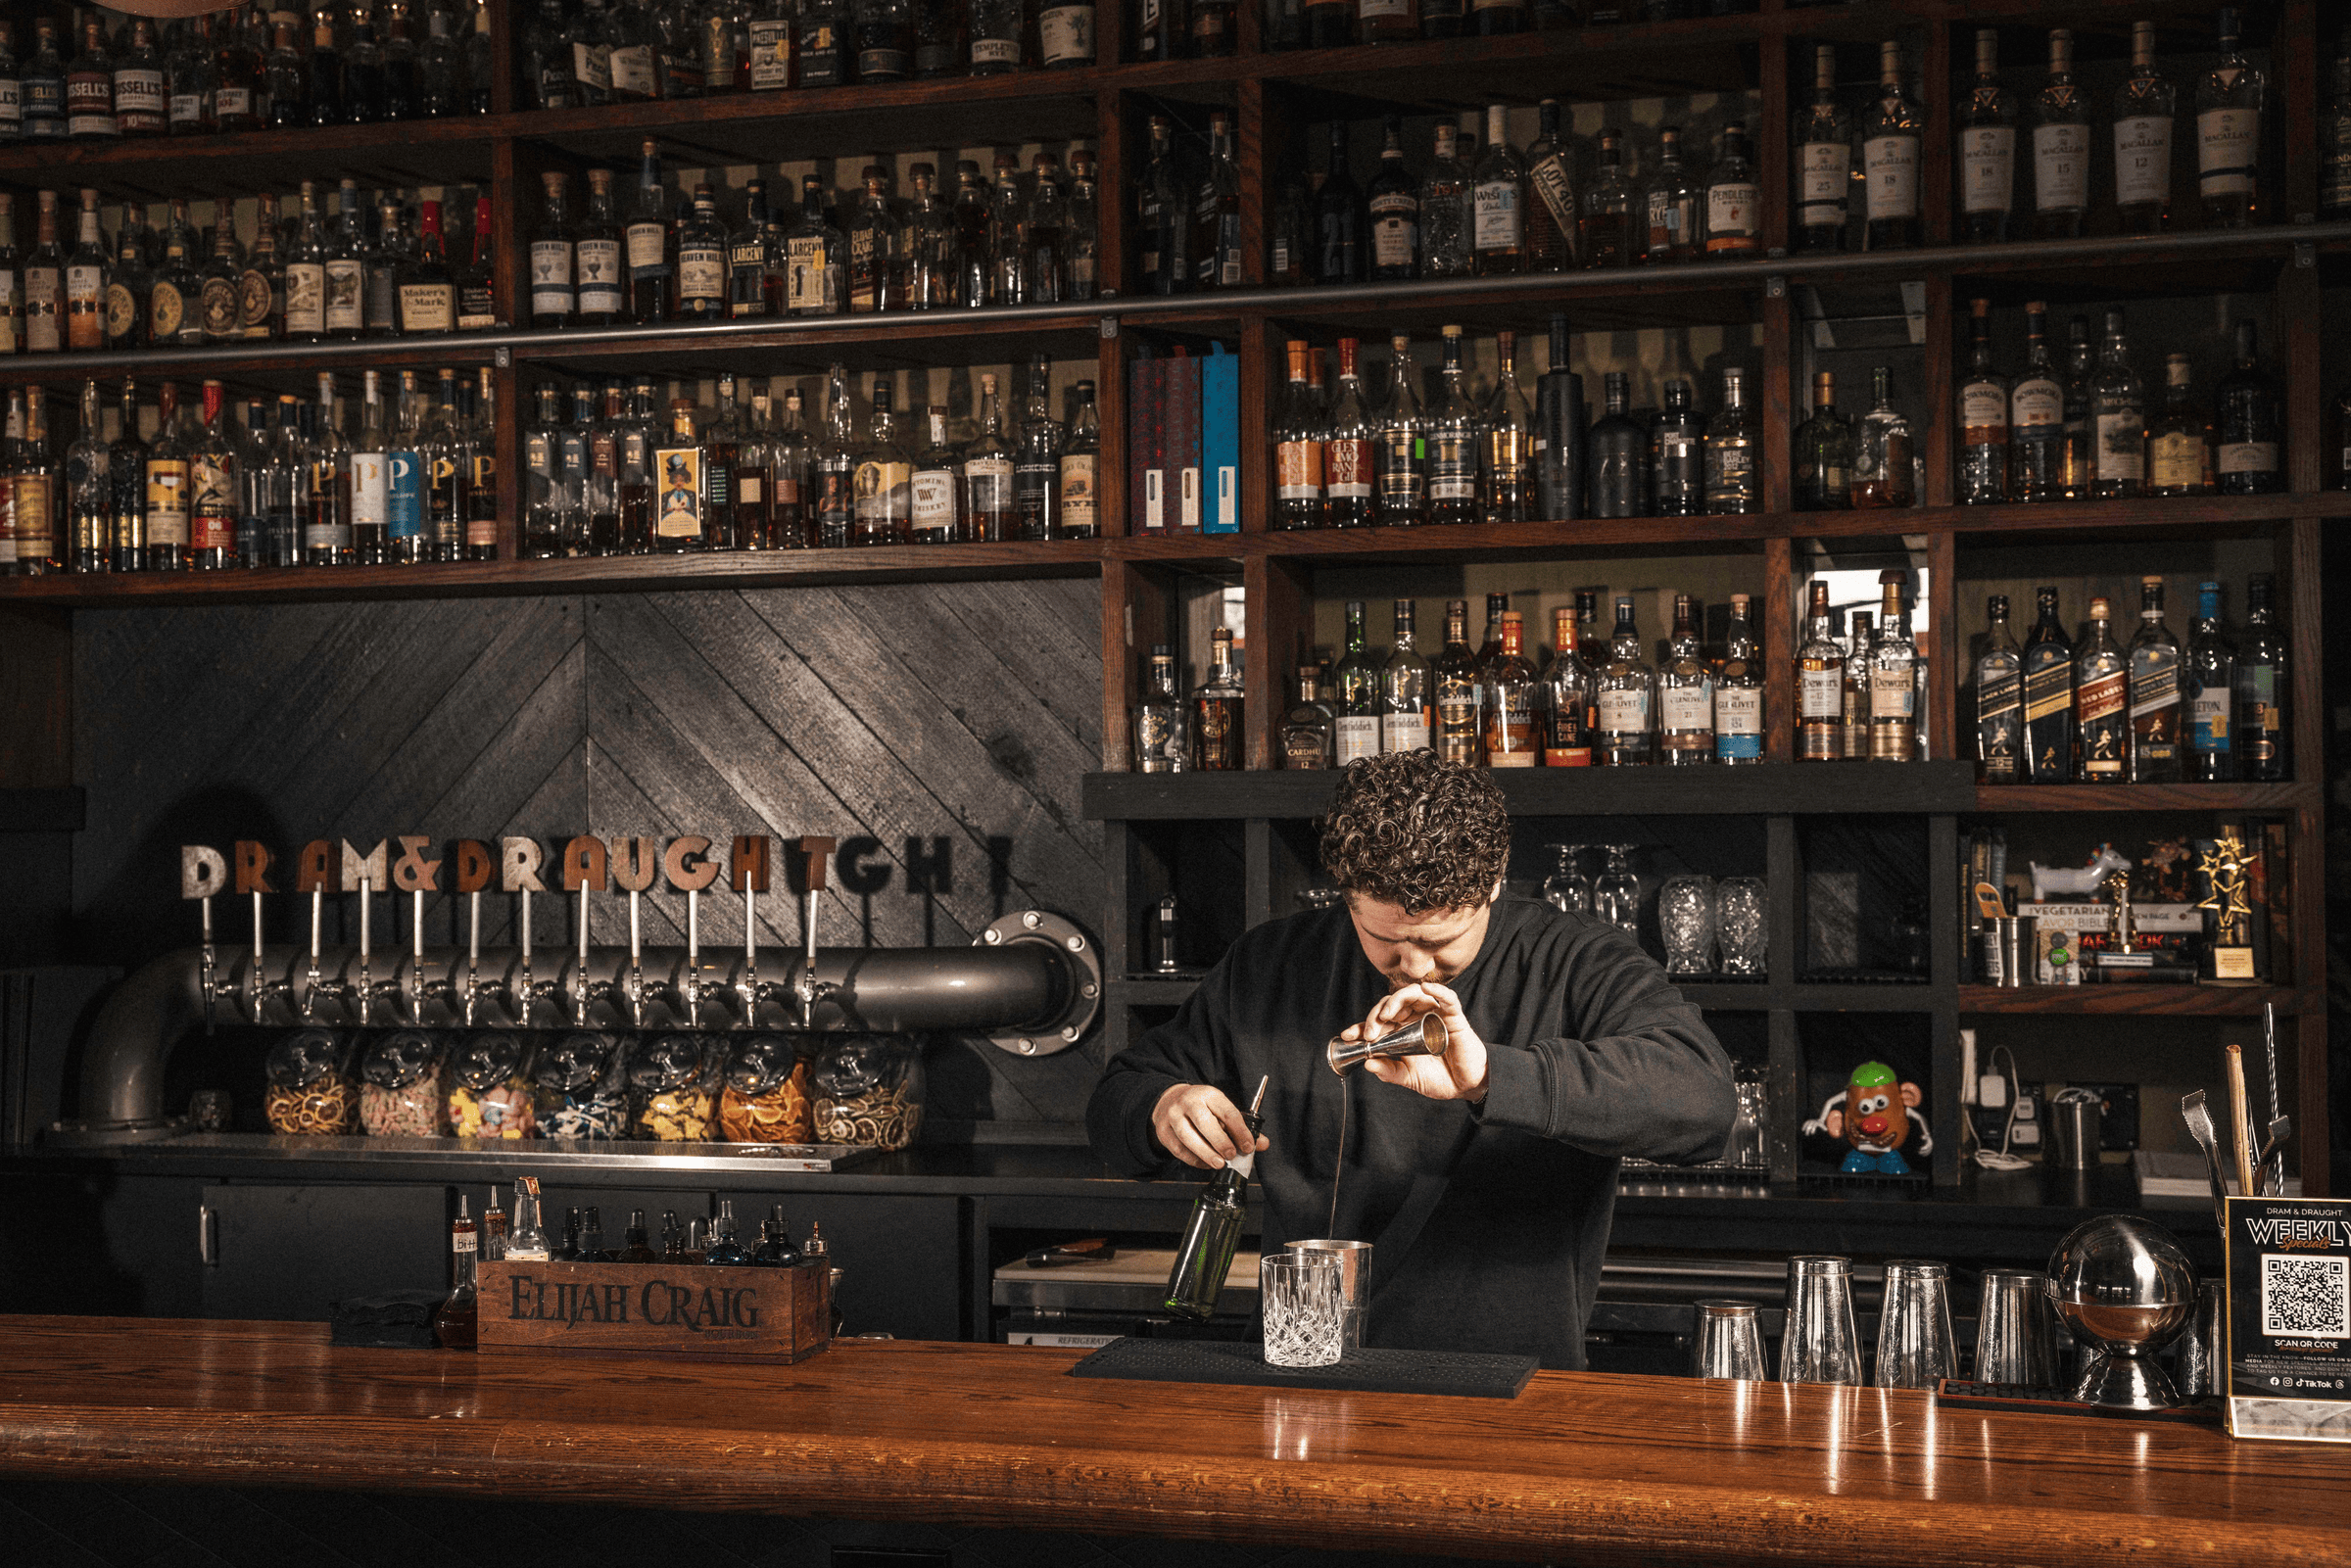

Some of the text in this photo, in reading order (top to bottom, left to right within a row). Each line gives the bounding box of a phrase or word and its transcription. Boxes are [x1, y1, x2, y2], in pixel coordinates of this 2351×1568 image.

[2135, 158, 2148, 167] 12
[1541, 160, 1574, 213] LOT 40
[1650, 205, 1669, 222] RYE
[415, 299, 446, 308] Mark
[1330, 442, 1359, 453] GLEN
[389, 459, 409, 491] P
[432, 458, 456, 490] P
[473, 455, 497, 488] P
[1287, 747, 1321, 758] CARDHU
[1301, 761, 1310, 770] 12
[457, 834, 838, 894] DRAUGHT
[2039, 917, 2074, 927] LAVOR
[2266, 1207, 2291, 1215] DRAM
[2301, 1208, 2343, 1217] DRAUGHT
[2245, 1217, 2351, 1247] WEEKLY
[2279, 1234, 2331, 1252] Specials
[507, 1274, 759, 1332] ELIJAH CRAIG
[2274, 1339, 2338, 1350] SCAN QR CODE
[2304, 1379, 2332, 1389] TikTok
